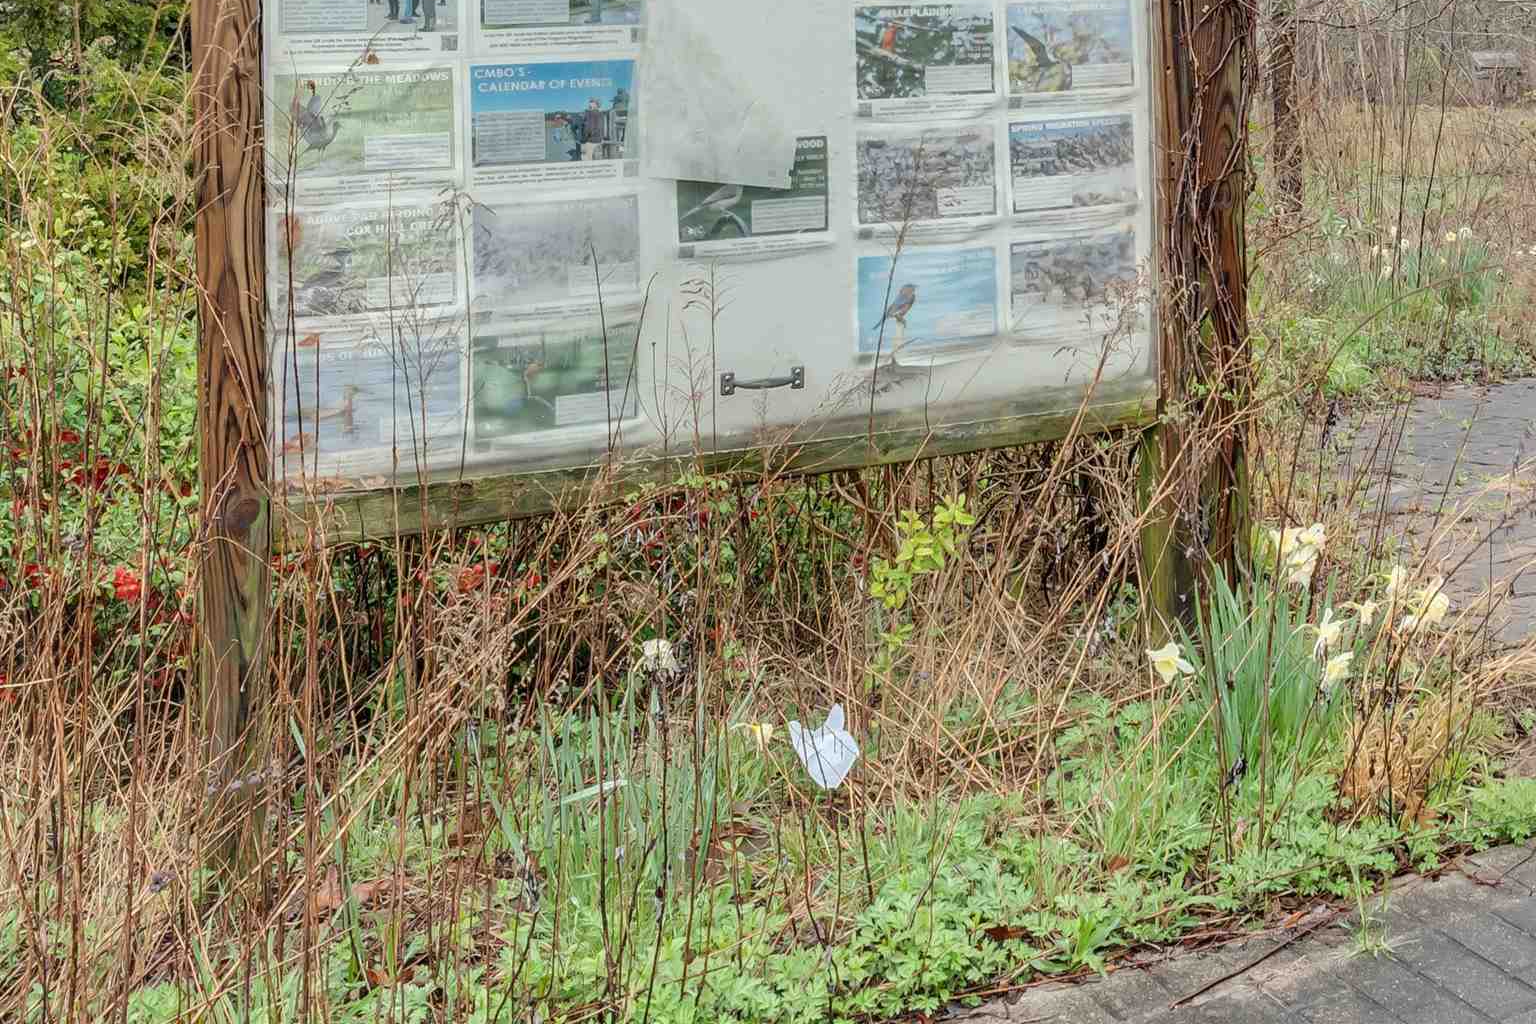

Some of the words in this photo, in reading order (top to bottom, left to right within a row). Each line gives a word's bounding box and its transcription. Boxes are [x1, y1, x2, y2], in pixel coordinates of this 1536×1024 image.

[386, 71, 449, 83] MEADOWS
[478, 80, 546, 93] CALENDAR
[548, 79, 566, 90] OF
